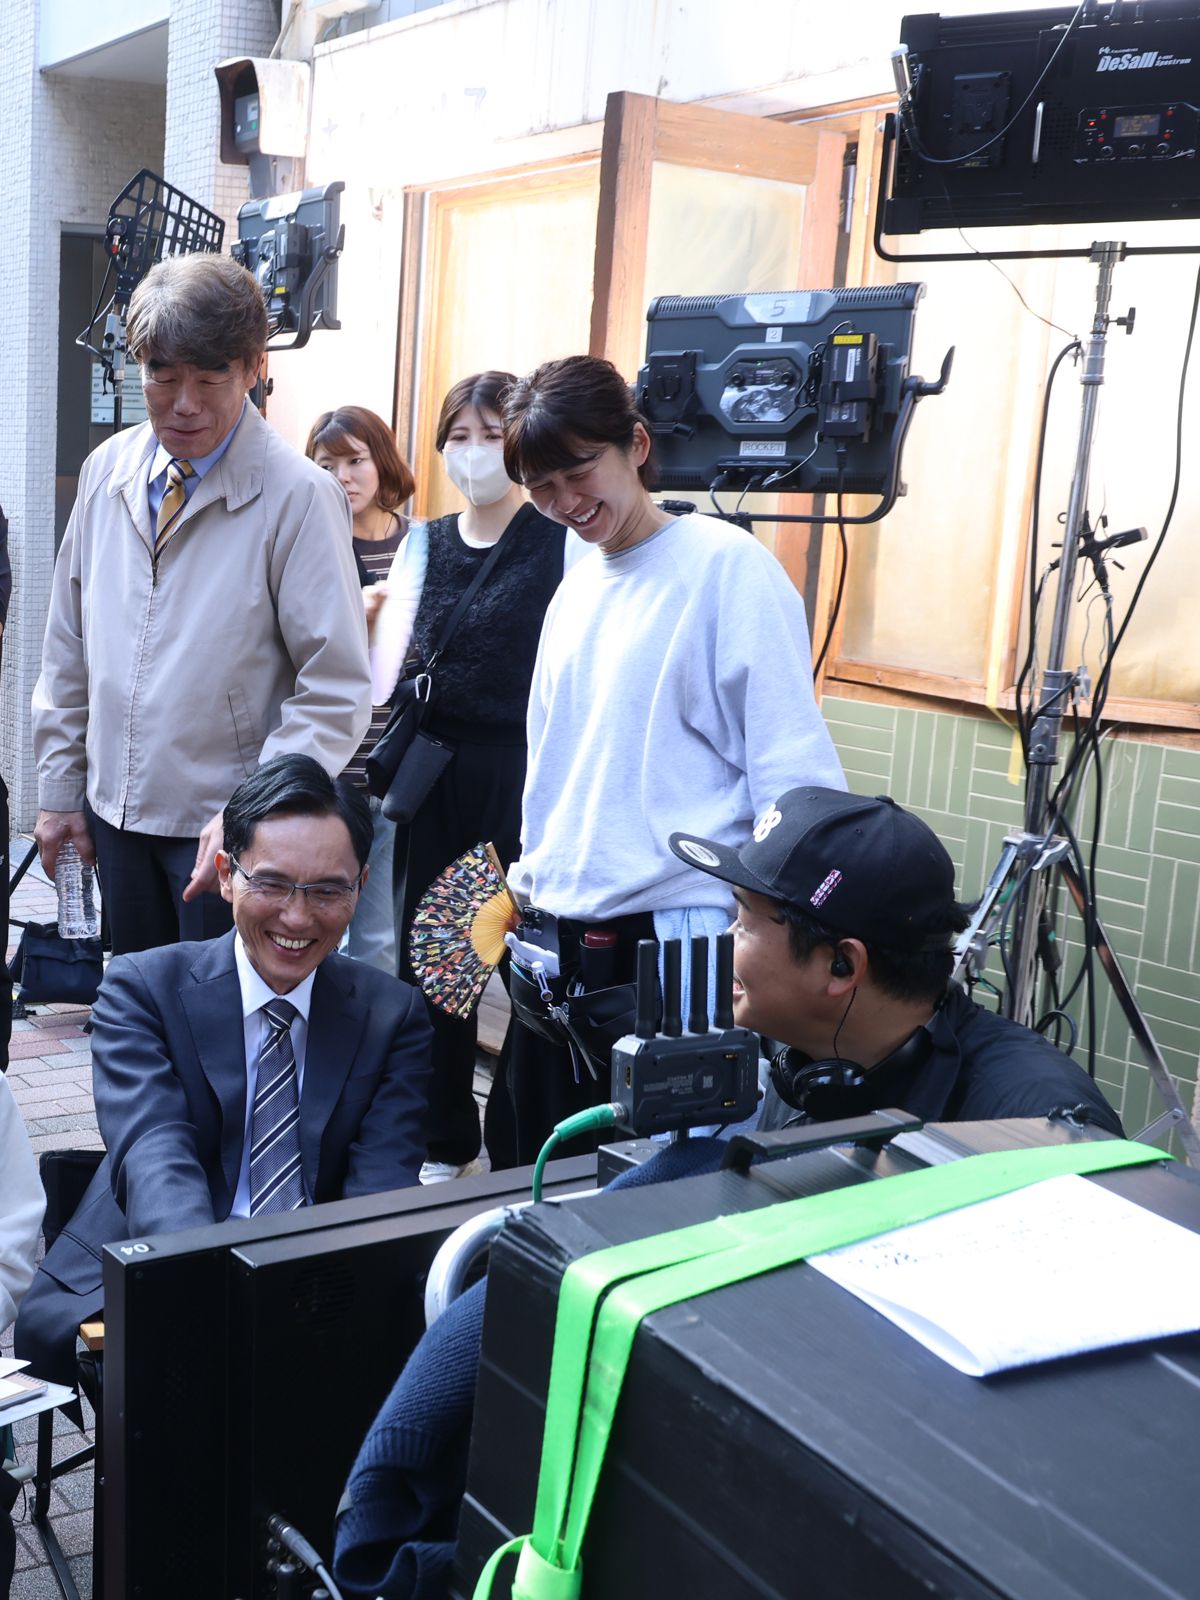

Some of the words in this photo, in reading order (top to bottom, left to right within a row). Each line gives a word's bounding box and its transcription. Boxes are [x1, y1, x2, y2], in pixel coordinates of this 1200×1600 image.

[770, 299, 787, 317] 5
[770, 330, 778, 339] 2
[120, 1243, 150, 1256] 04
